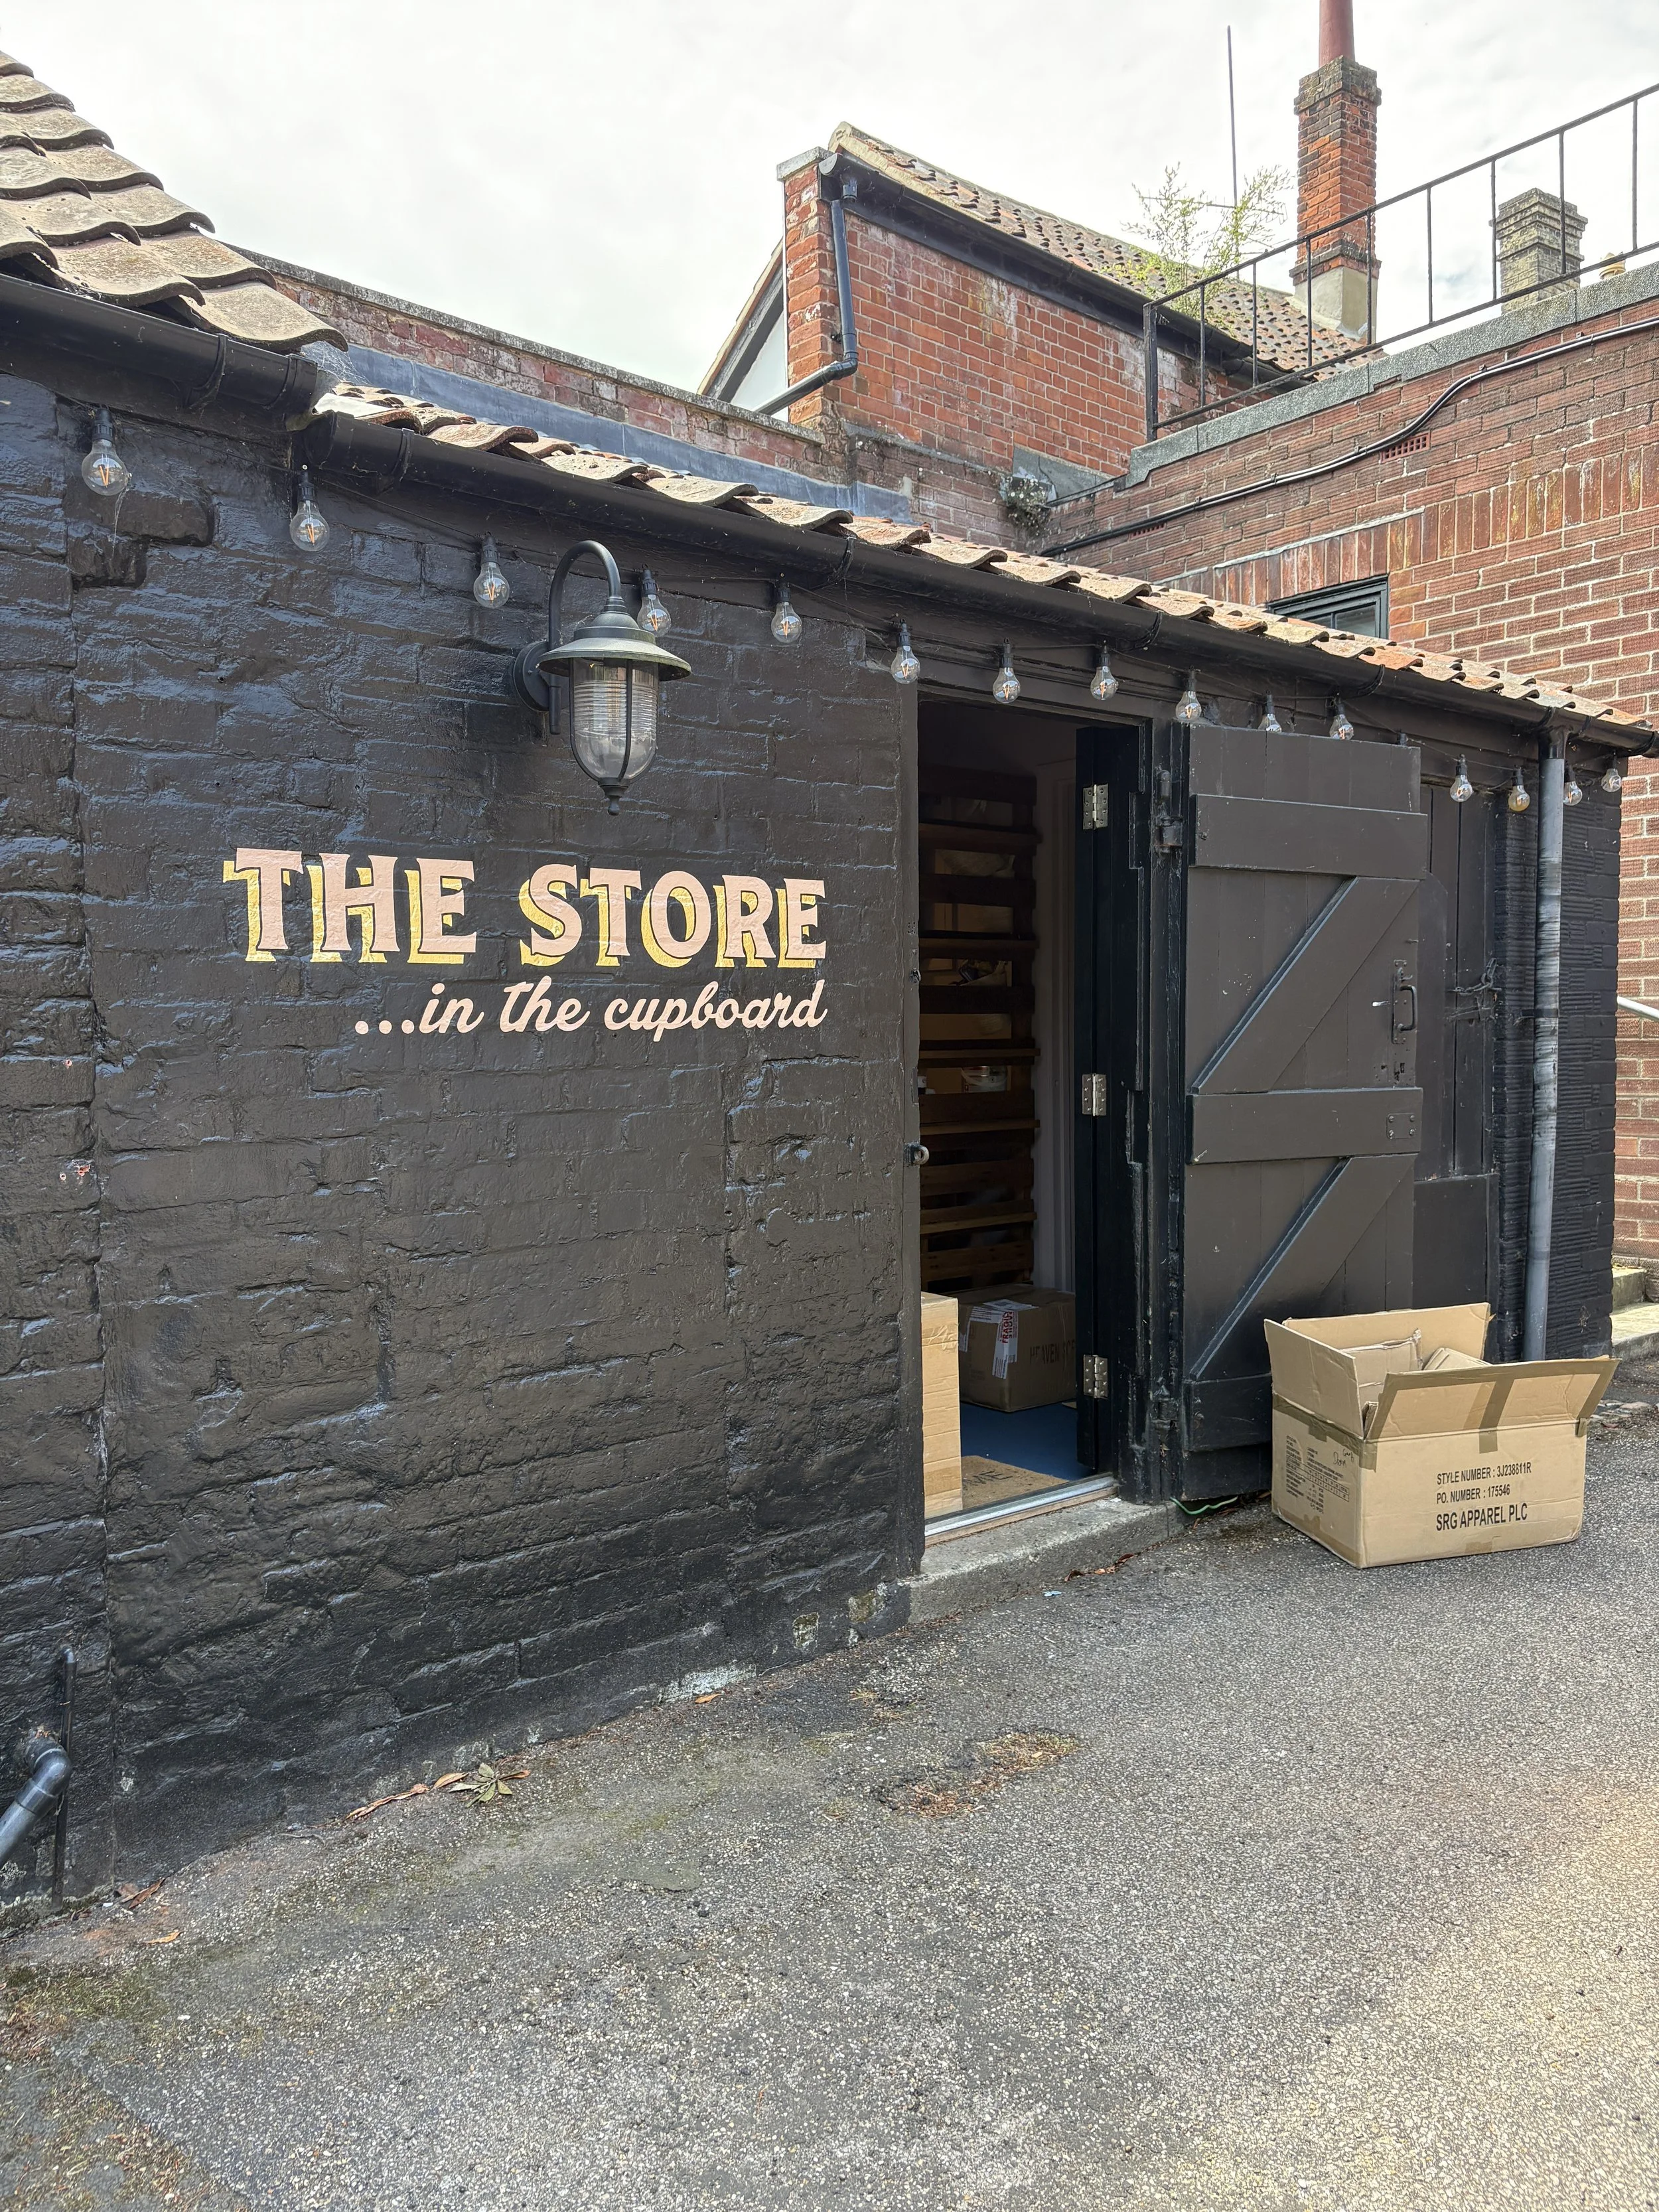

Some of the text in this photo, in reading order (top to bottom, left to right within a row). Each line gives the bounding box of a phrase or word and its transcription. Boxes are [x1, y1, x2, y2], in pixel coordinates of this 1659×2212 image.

[223, 847, 827, 968] THE STORE
[500, 975, 591, 1033] the
[604, 979, 828, 1043] cupboard
[1437, 1471, 1460, 1485] STYLE
[1461, 1467, 1491, 1482] NUMBER
[1496, 1461, 1532, 1477] 3J238811R
[1437, 1492, 1449, 1505] PO.
[1450, 1487, 1480, 1503] NUMBER
[1488, 1483, 1510, 1498] 175546
[1435, 1503, 1528, 1532] SRG APPAREL PLC
